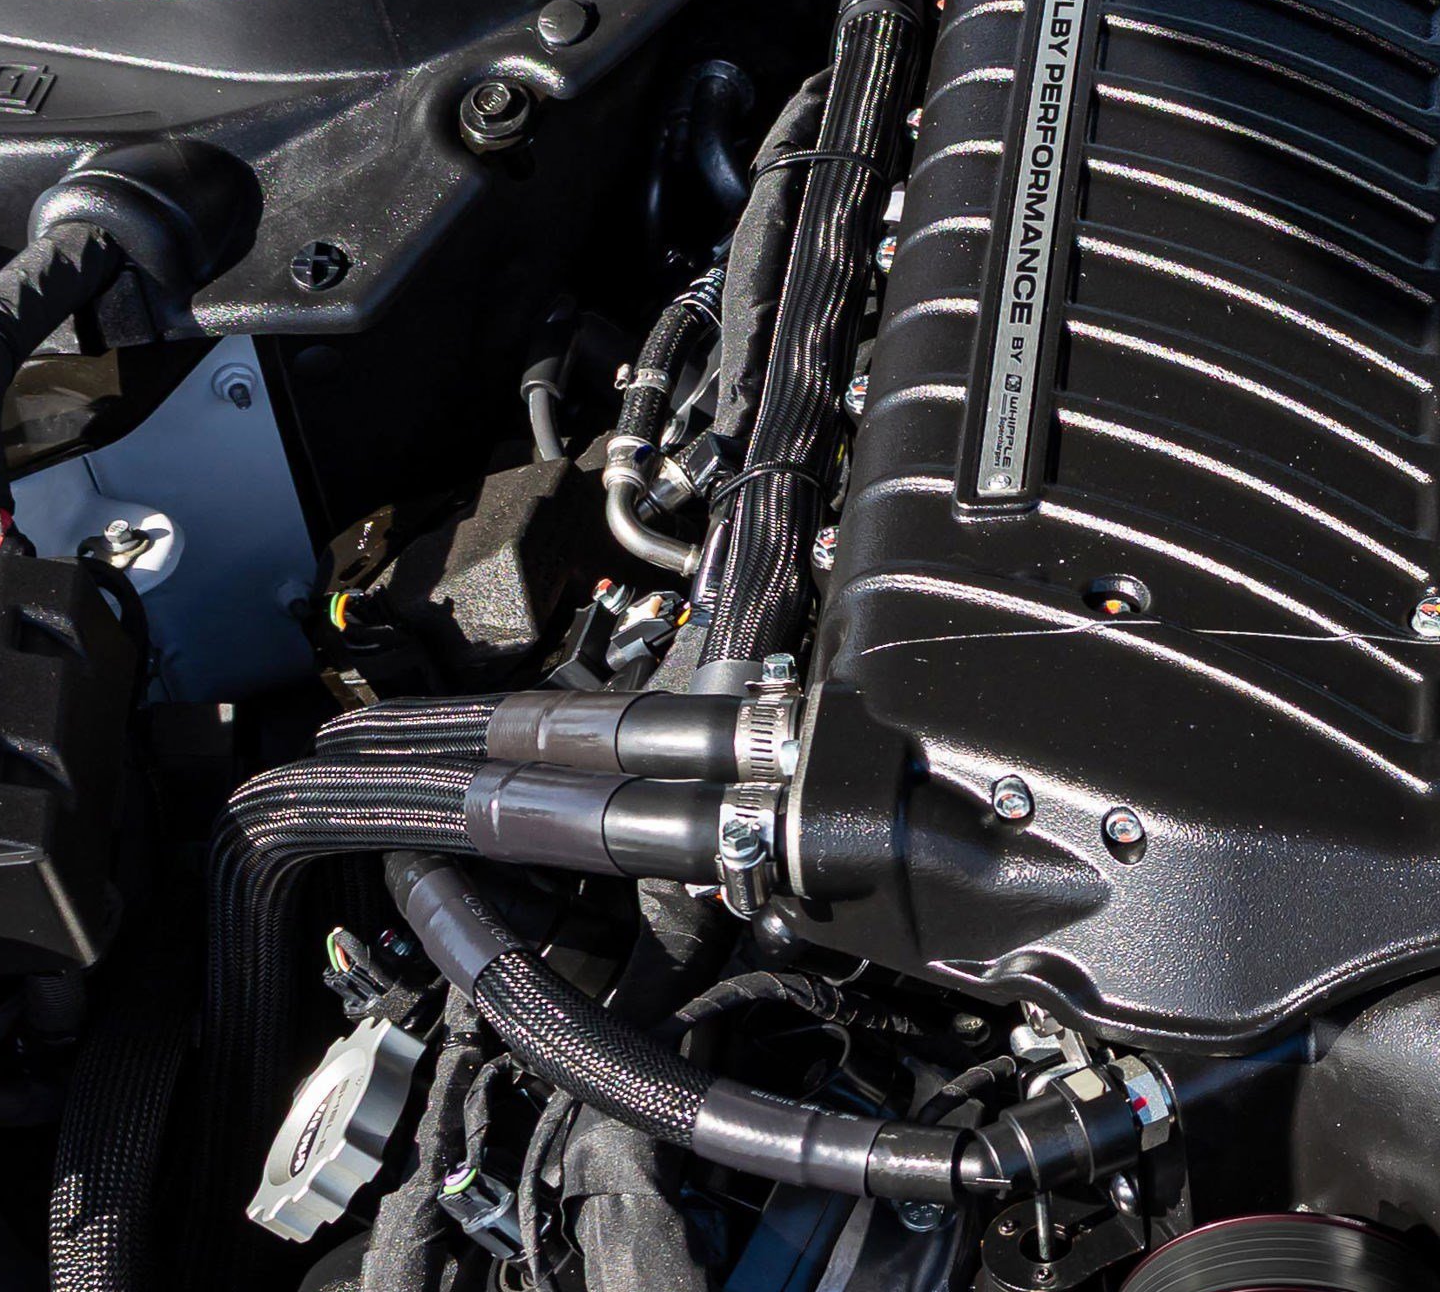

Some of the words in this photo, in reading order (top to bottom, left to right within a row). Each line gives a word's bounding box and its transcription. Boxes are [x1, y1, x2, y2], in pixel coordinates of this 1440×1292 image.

[1007, 62, 1066, 326] PERFORMANCE
[1007, 336, 1026, 364] BY
[1000, 393, 1021, 469] WHIPPLE
